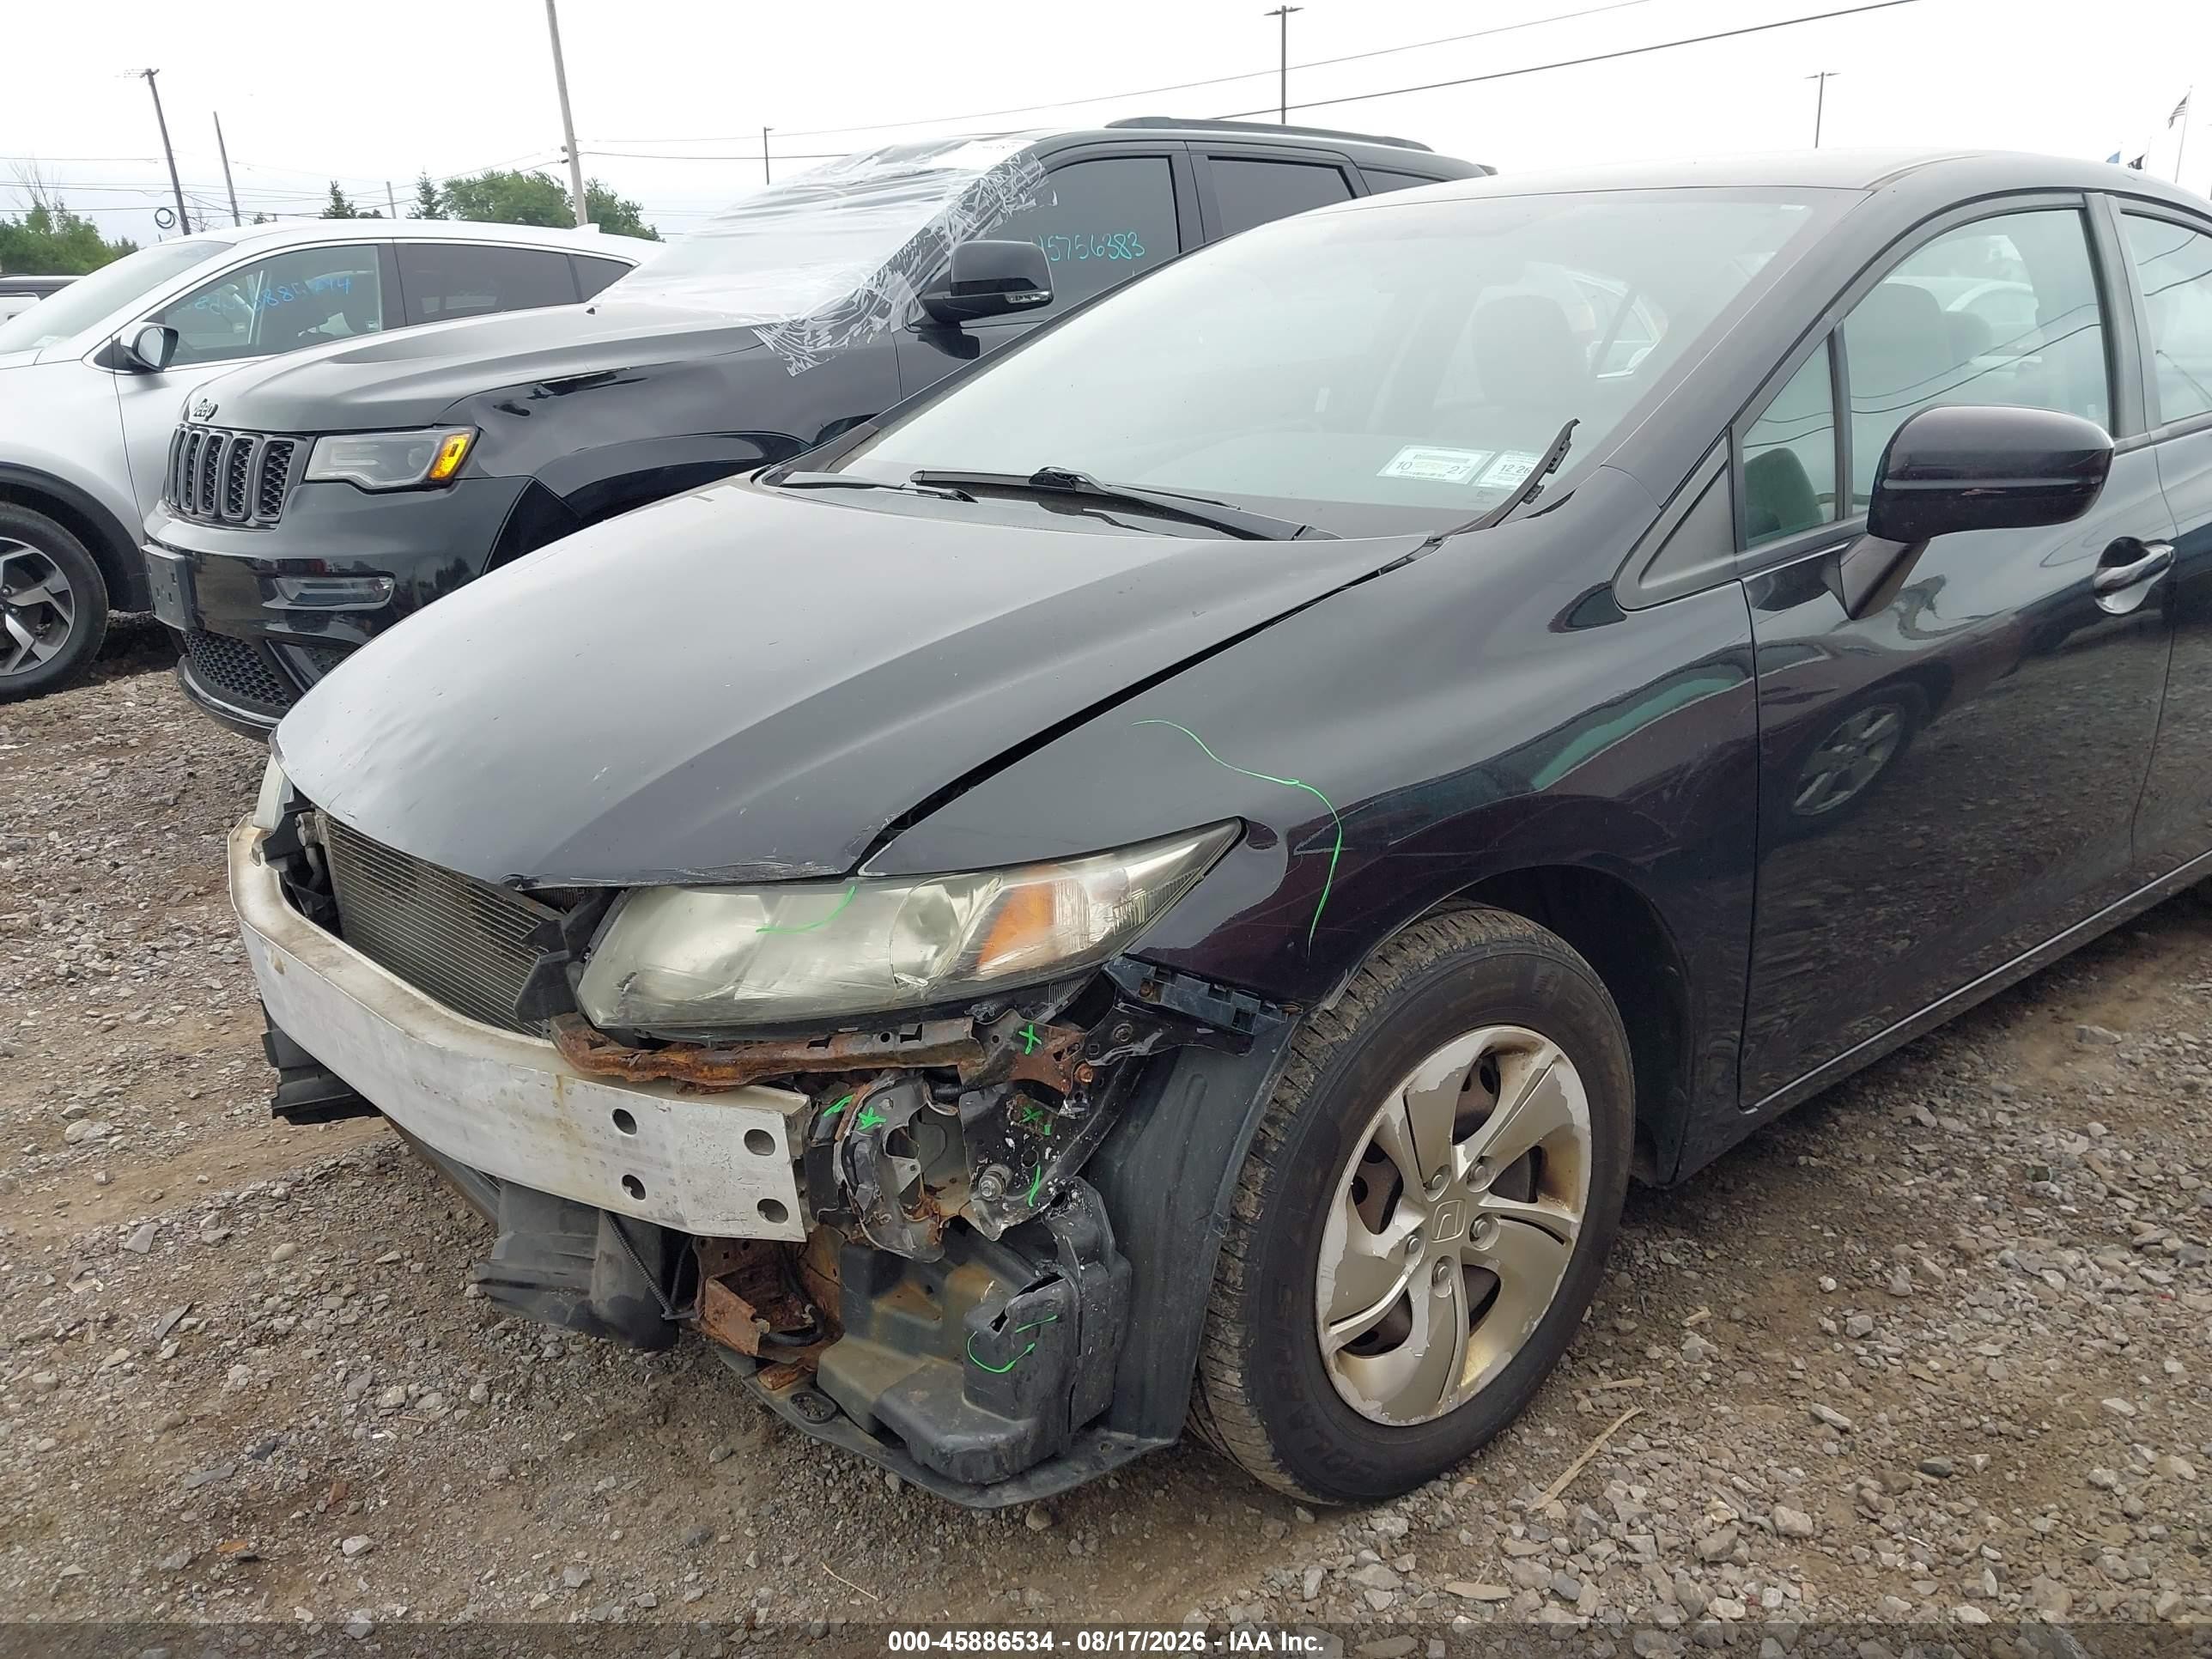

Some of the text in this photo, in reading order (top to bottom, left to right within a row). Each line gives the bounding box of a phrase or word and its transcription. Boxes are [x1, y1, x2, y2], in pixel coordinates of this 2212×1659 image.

[193, 398, 219, 422] Jeep
[1395, 460, 1471, 475] 10 27
[1500, 464, 1516, 472] 12
